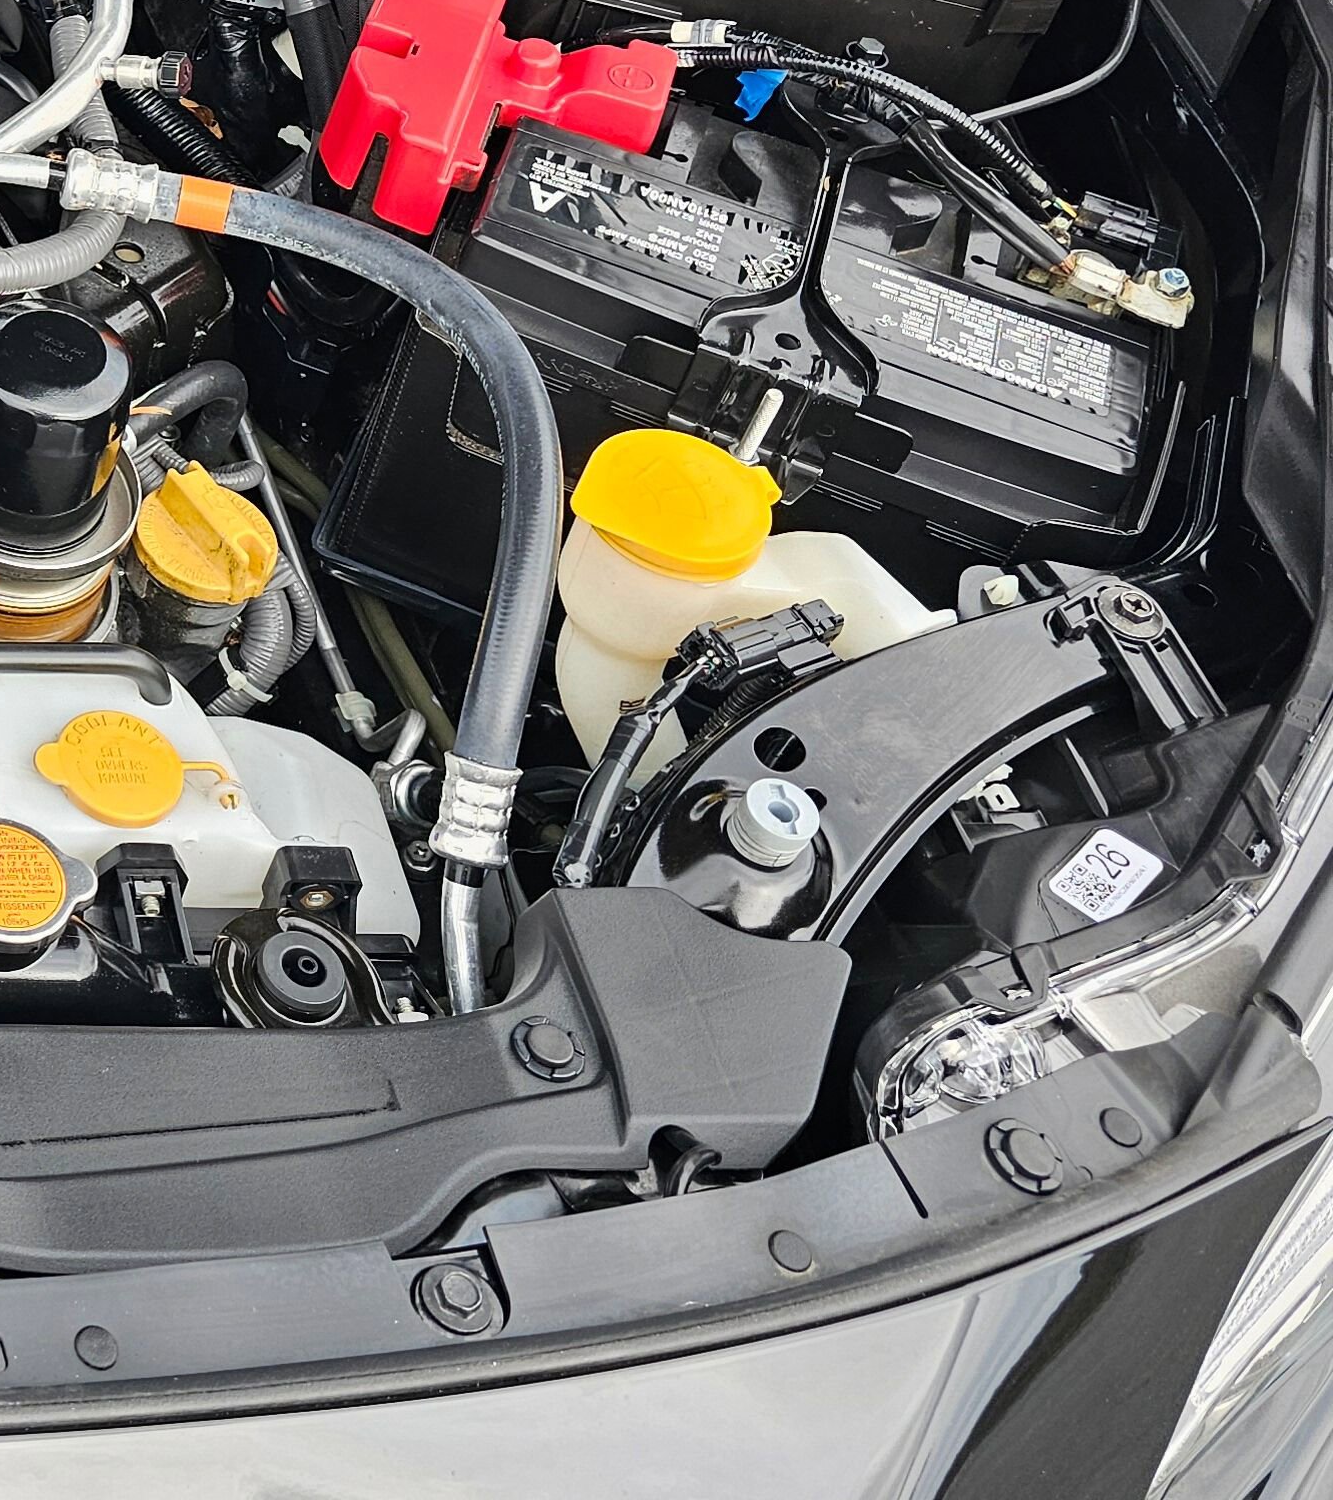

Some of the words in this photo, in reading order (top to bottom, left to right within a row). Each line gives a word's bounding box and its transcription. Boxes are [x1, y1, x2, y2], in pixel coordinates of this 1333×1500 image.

[596, 224, 628, 241] AMPS
[647, 233, 688, 253] AMPS
[627, 235, 684, 261] CRANKING
[1085, 843, 1130, 880] 26
